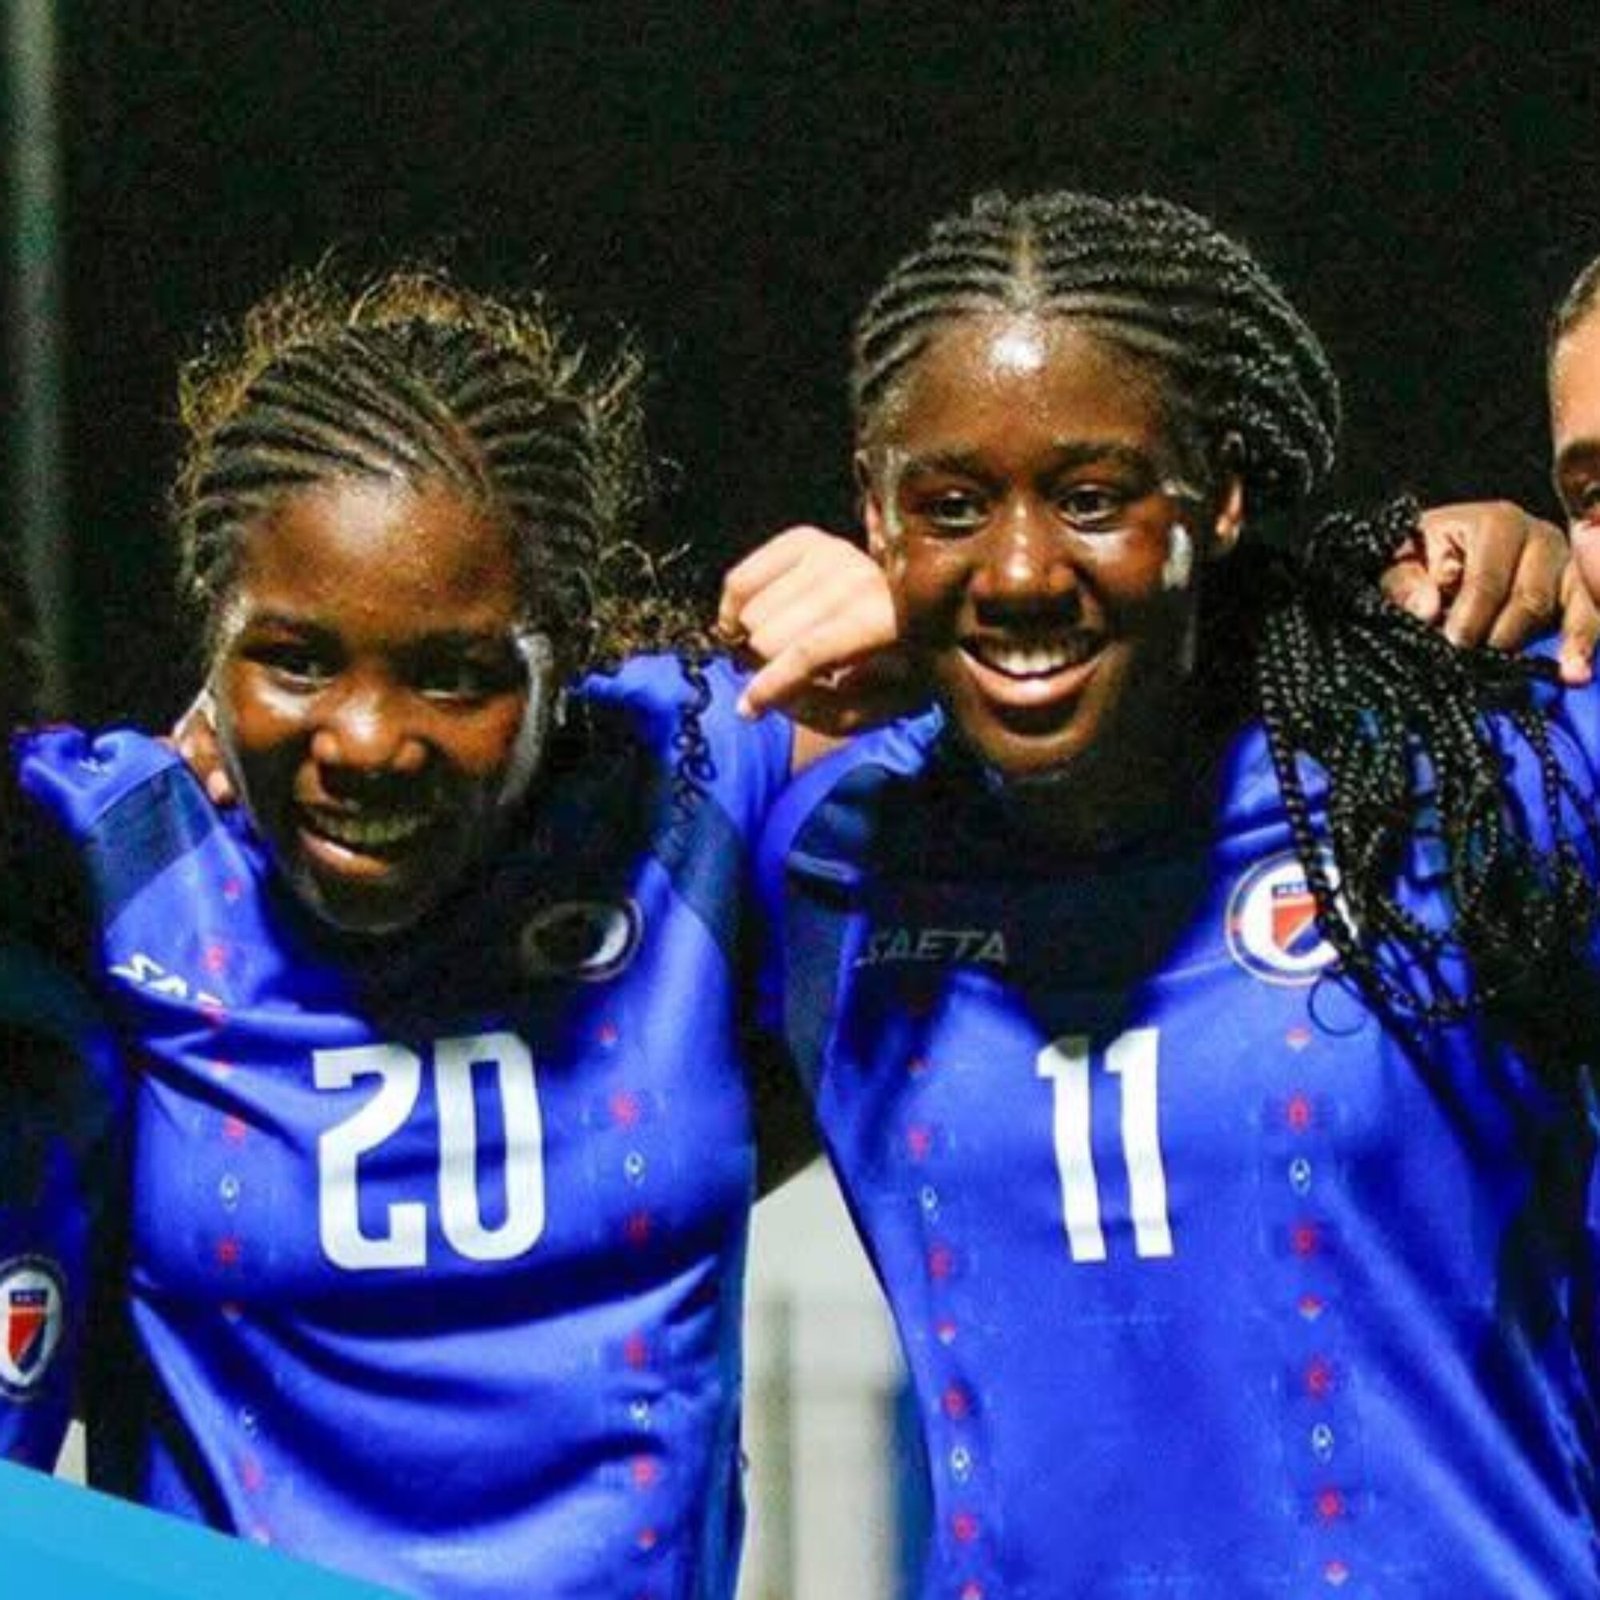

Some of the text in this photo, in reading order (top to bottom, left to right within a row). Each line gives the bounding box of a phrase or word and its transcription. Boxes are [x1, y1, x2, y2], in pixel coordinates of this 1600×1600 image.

[854, 927, 1007, 968] SAETA
[313, 1031, 545, 1269] 20
[1036, 1027, 1174, 1263] 11
